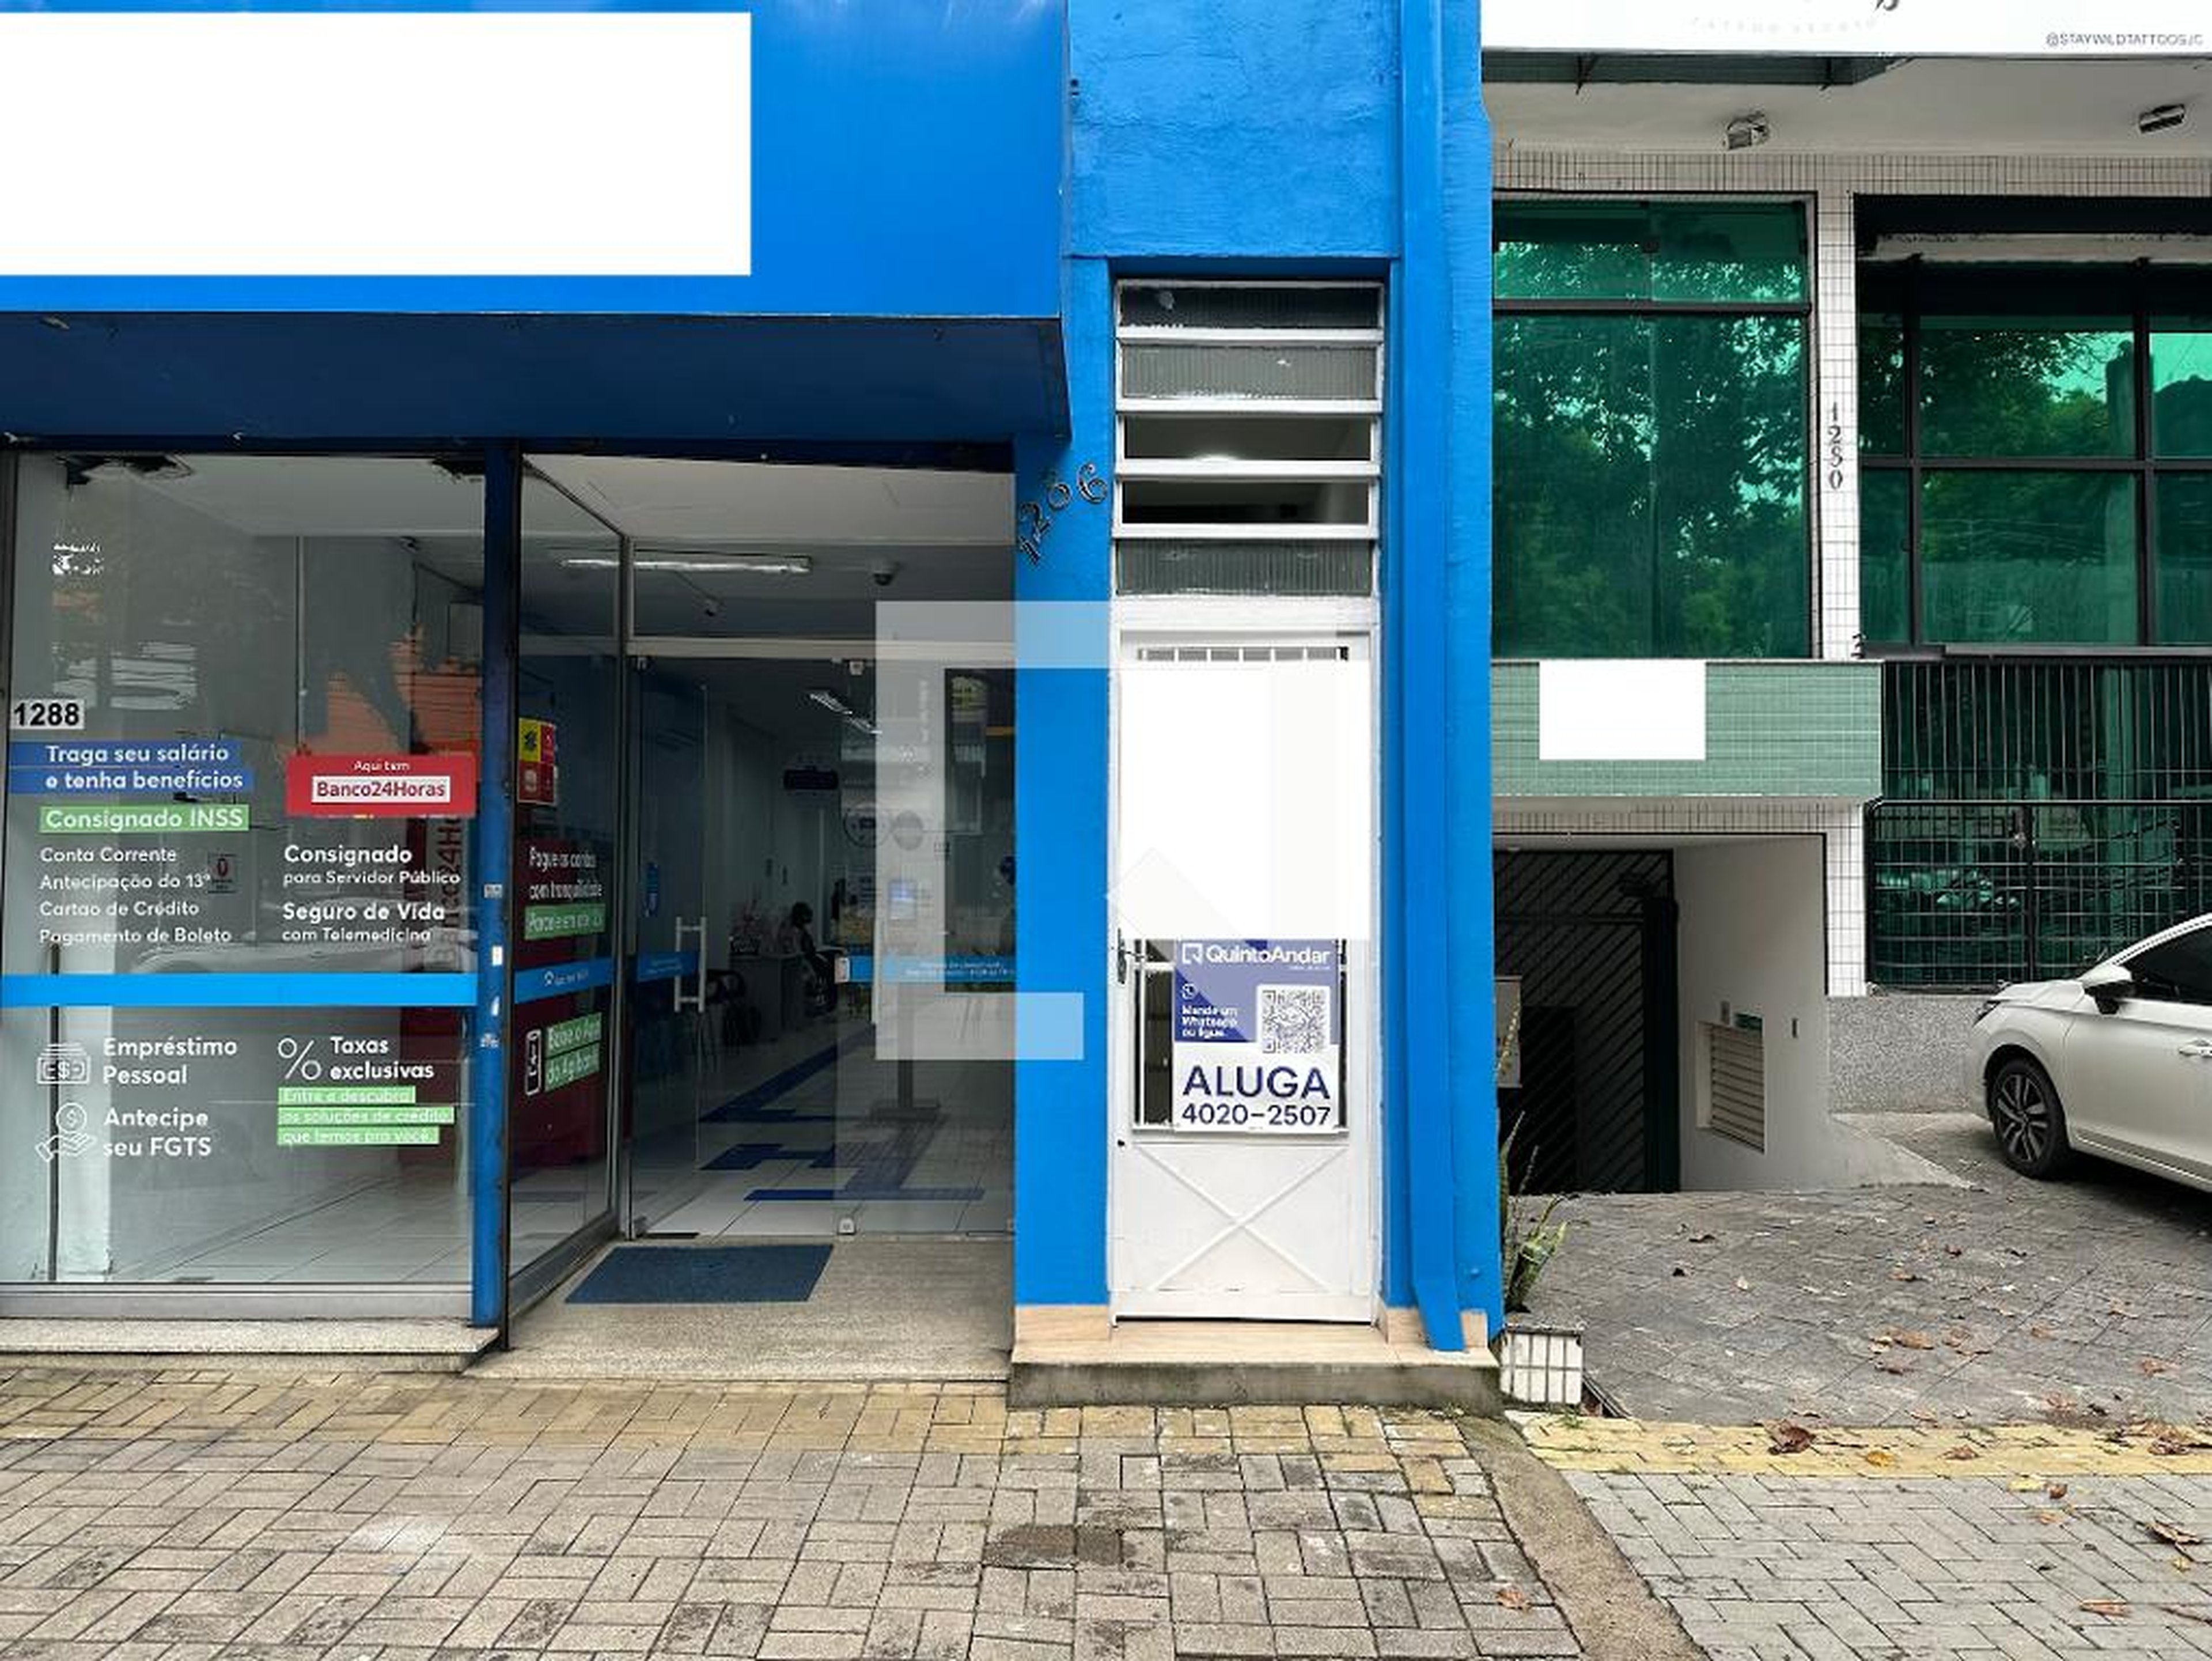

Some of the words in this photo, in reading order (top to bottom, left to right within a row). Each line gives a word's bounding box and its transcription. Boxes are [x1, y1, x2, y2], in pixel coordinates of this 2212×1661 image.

[14, 702, 79, 727] 1288
[46, 744, 108, 766] Traga
[114, 748, 150, 762] seu
[157, 743, 229, 762] salário
[354, 760, 382, 773] Aqui
[384, 760, 410, 771] tem
[65, 771, 126, 789] tenha
[133, 770, 243, 789] benefícios
[317, 782, 445, 797] Banco24Horas
[46, 809, 183, 832] Consignado
[191, 808, 243, 827] INSS
[40, 847, 94, 862] Conta
[100, 847, 177, 862] Corrente
[284, 844, 412, 867] Consignado
[158, 873, 180, 888] do
[283, 872, 321, 888] para
[326, 870, 394, 884] Servidor
[399, 869, 461, 884] Público
[106, 901, 129, 916] de
[133, 901, 199, 916] Crédito
[283, 902, 357, 924] Seguro
[363, 902, 389, 921] de
[397, 902, 445, 920] Vida
[39, 928, 142, 947] Pagamento
[147, 927, 169, 943] de
[175, 926, 232, 943] Boleto
[282, 929, 317, 941] com
[322, 927, 431, 942] Telemedicina
[1206, 945, 1330, 964] QuintoAndar
[103, 1036, 237, 1060] Empréstimo
[330, 1036, 389, 1054] Taxas
[103, 1064, 187, 1084] Pessoal
[330, 1061, 434, 1080] exclusivas
[1181, 1065, 1331, 1099] ALUGA
[104, 1107, 209, 1132] Antecipe
[1181, 1104, 1331, 1126] 4020-2507
[102, 1142, 142, 1156] seu
[150, 1137, 211, 1156] FGTS
